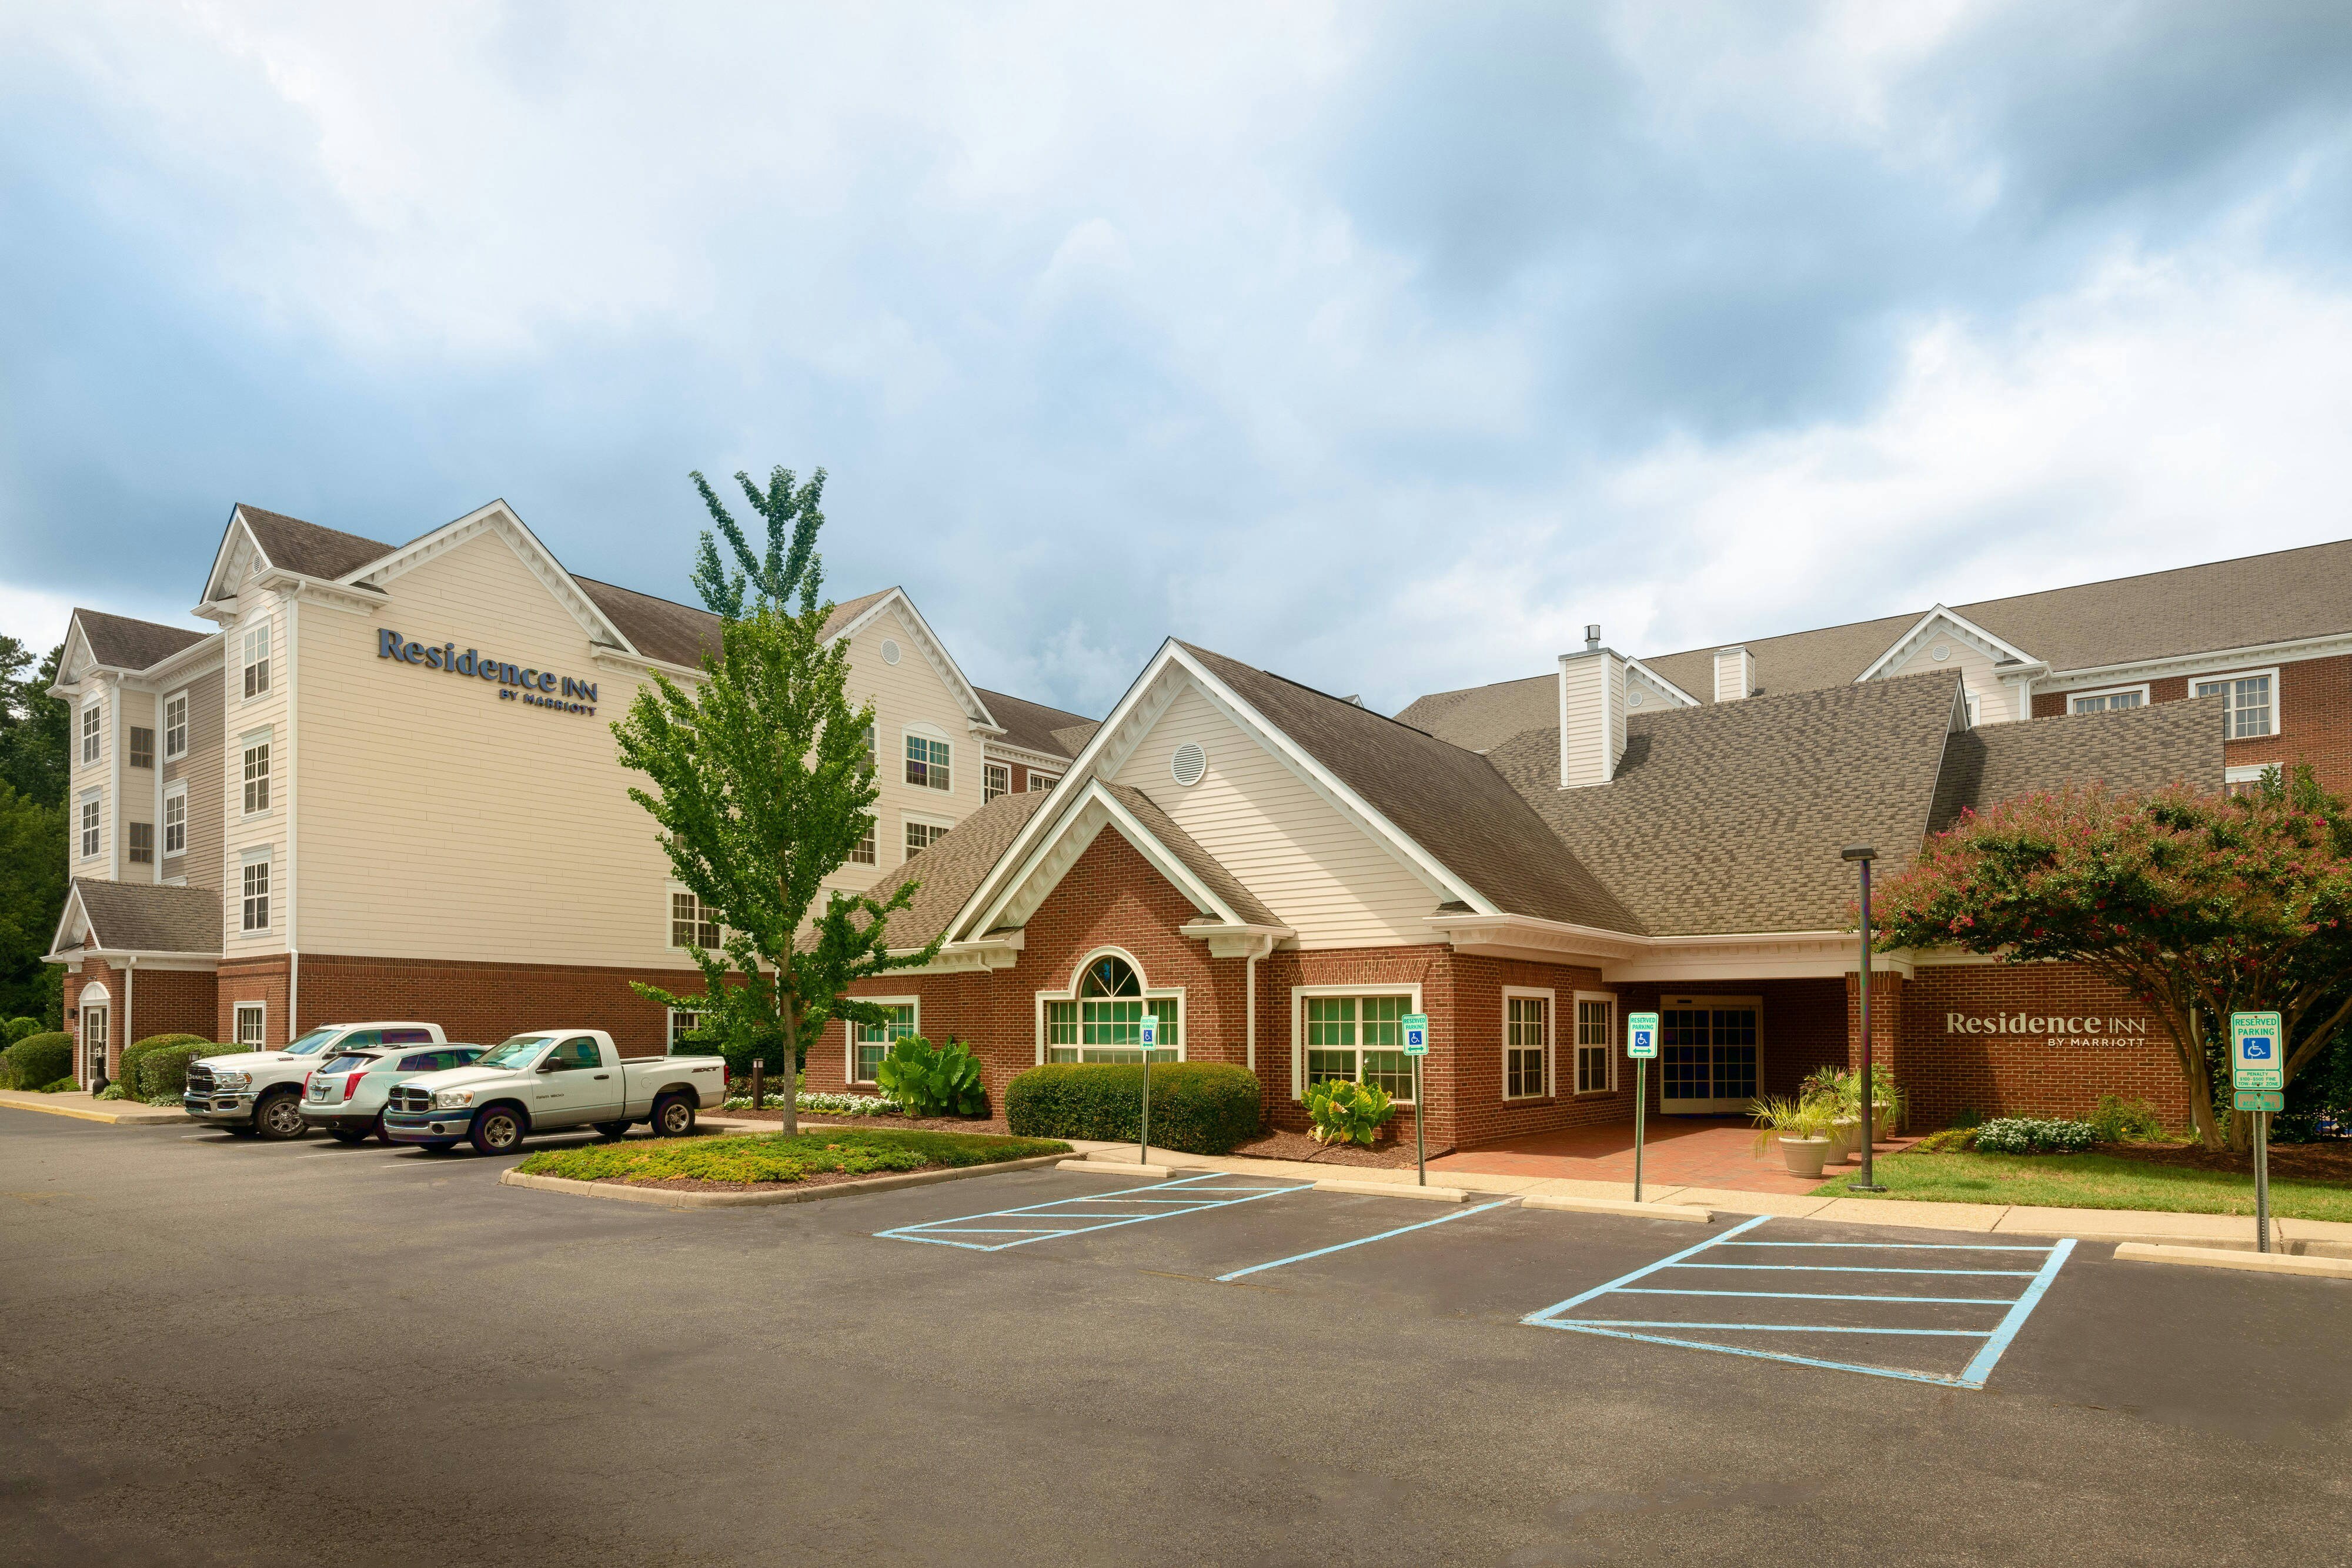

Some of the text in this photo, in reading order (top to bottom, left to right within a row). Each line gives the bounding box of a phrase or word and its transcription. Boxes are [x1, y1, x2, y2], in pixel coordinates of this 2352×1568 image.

[377, 628, 597, 703] Residence INN
[499, 688, 597, 717] BY MARRIOTT
[1946, 1012, 2145, 1034] Residence INN
[2048, 1038, 2145, 1047] BY MARRIOTT
